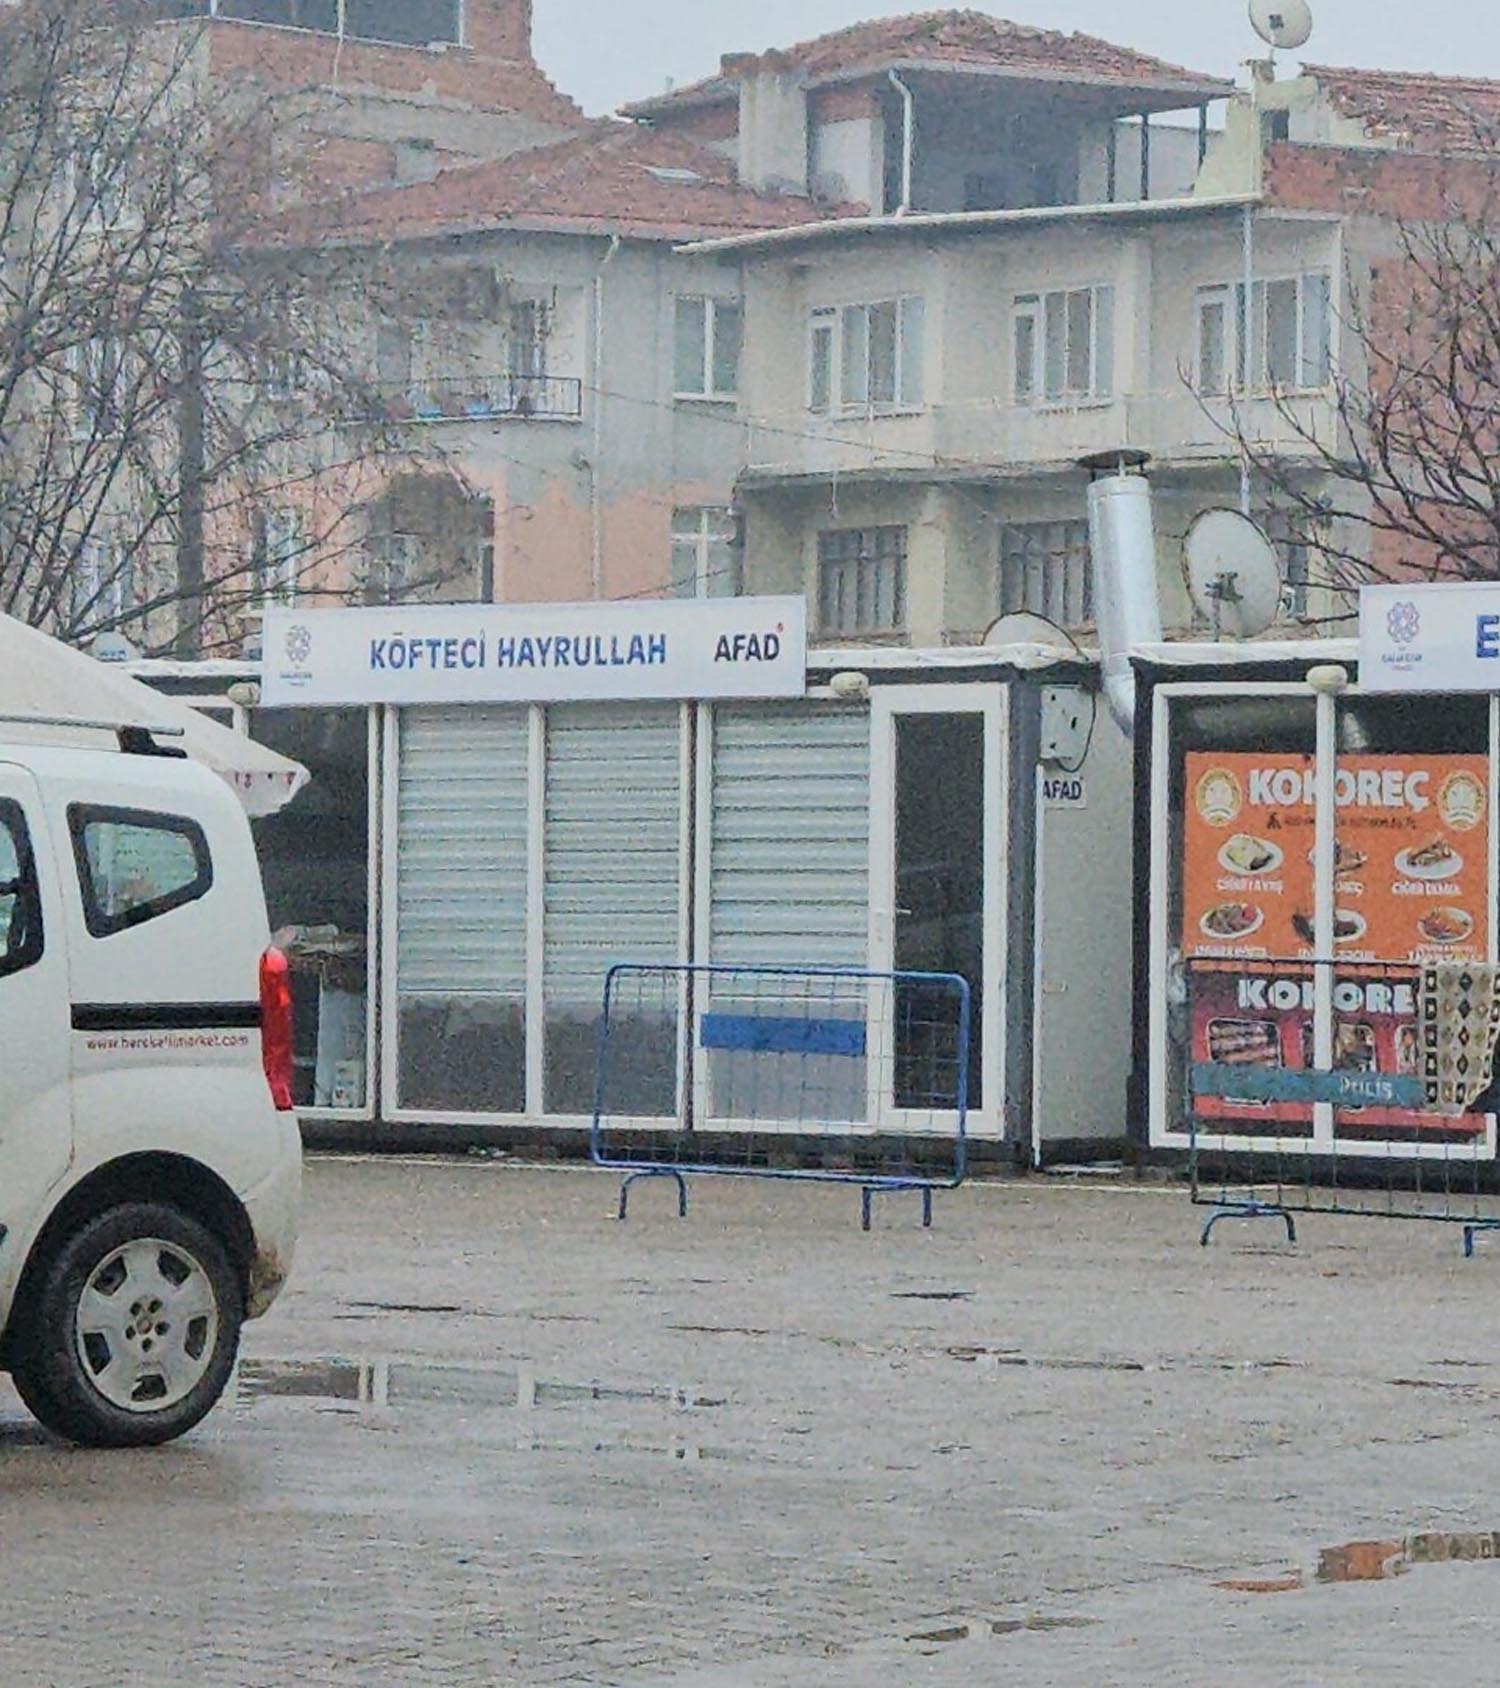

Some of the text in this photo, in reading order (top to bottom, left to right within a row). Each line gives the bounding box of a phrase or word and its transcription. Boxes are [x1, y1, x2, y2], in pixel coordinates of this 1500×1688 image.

[370, 629, 667, 670] KÖFTECİ HAYRULLAH
[713, 632, 781, 663] AFAD
[1042, 780, 1082, 800] AFAD
